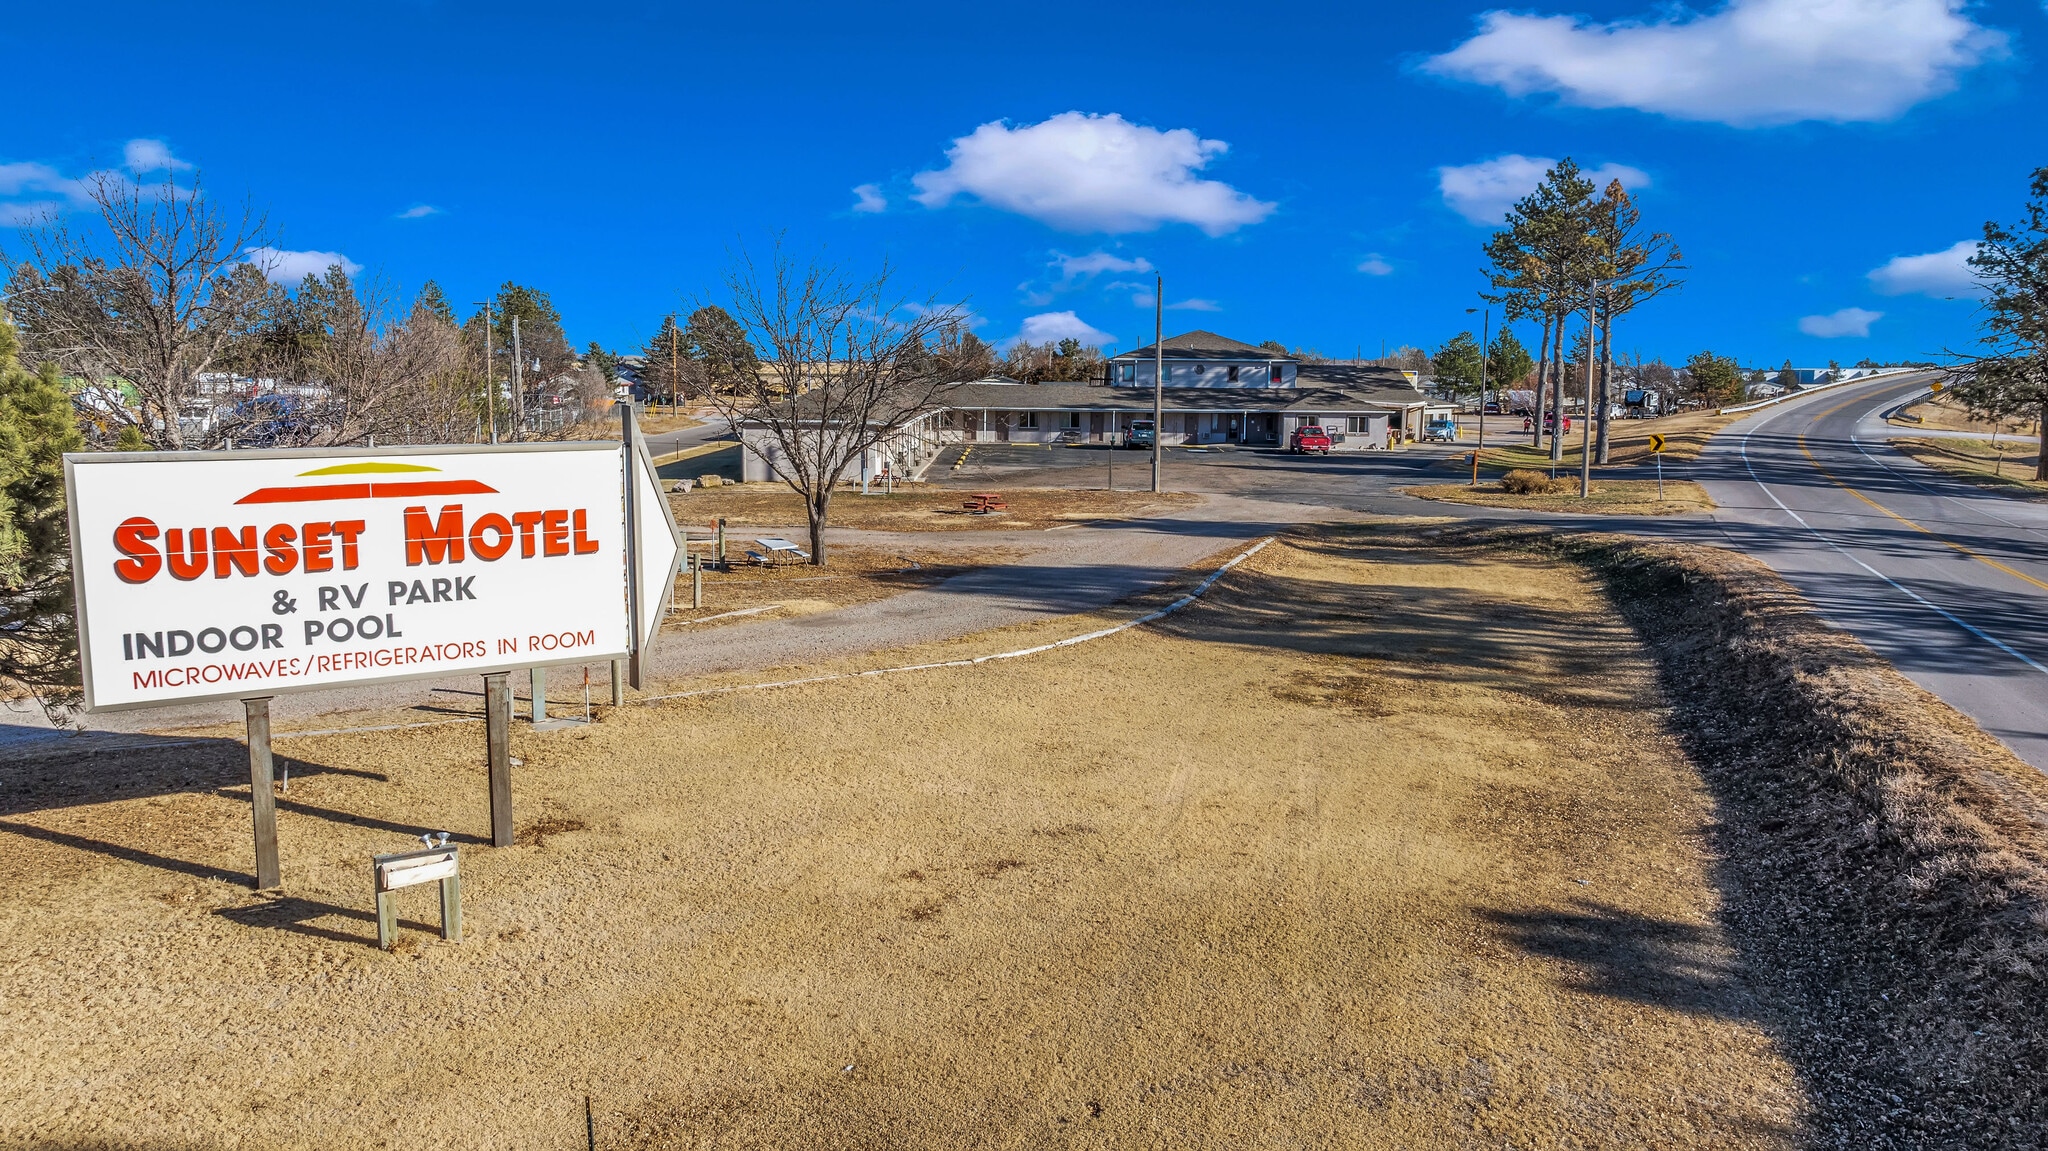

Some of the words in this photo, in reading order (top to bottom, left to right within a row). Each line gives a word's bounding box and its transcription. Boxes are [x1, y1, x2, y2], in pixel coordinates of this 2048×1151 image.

[113, 517, 366, 584] SUNSET
[403, 504, 599, 567] MOTEL
[271, 589, 298, 615] &
[318, 582, 369, 612] RV
[388, 575, 477, 606] PARK
[123, 623, 284, 661] INDOOR
[304, 613, 402, 646] POOL
[497, 637, 517, 655] IN
[528, 629, 595, 652] ROOM
